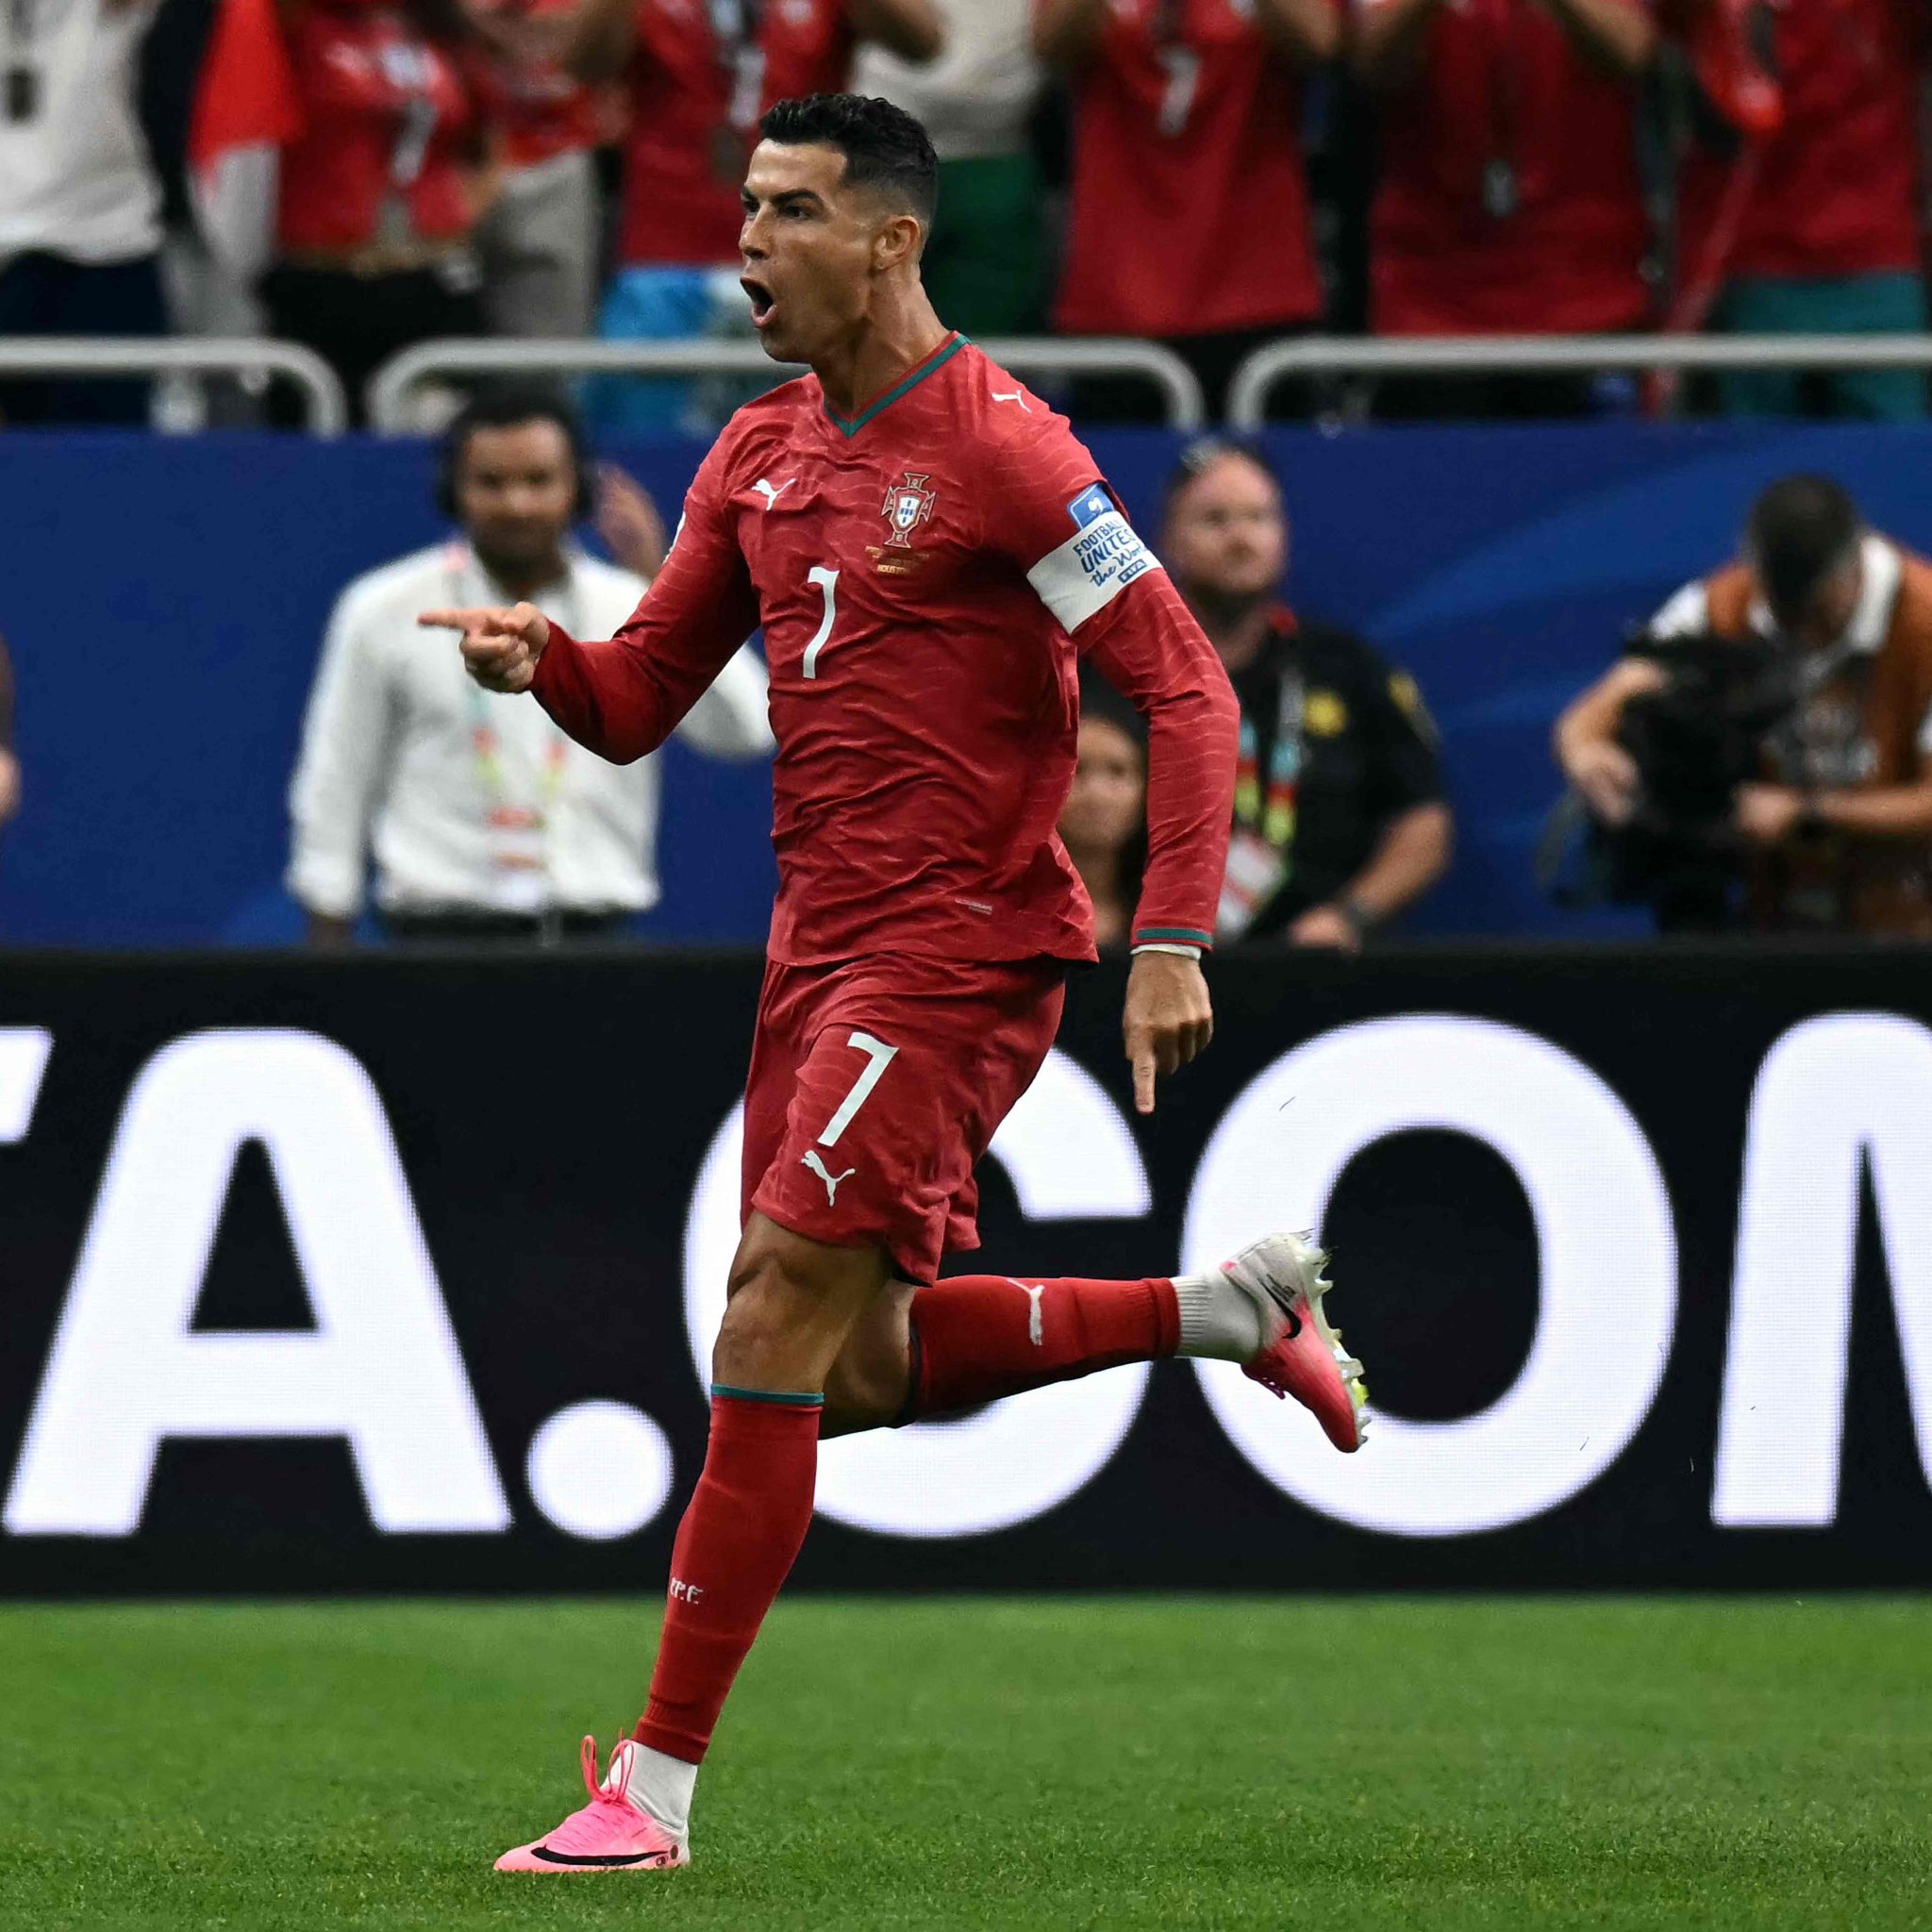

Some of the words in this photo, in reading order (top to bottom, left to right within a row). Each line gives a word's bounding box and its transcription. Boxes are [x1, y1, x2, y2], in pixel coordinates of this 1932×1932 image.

[1073, 519, 1124, 557] FOOTBALL
[1080, 529, 1136, 574] UNITES
[1089, 566, 1117, 587] the
[803, 566, 840, 679] 7
[817, 1032, 899, 1147] 7
